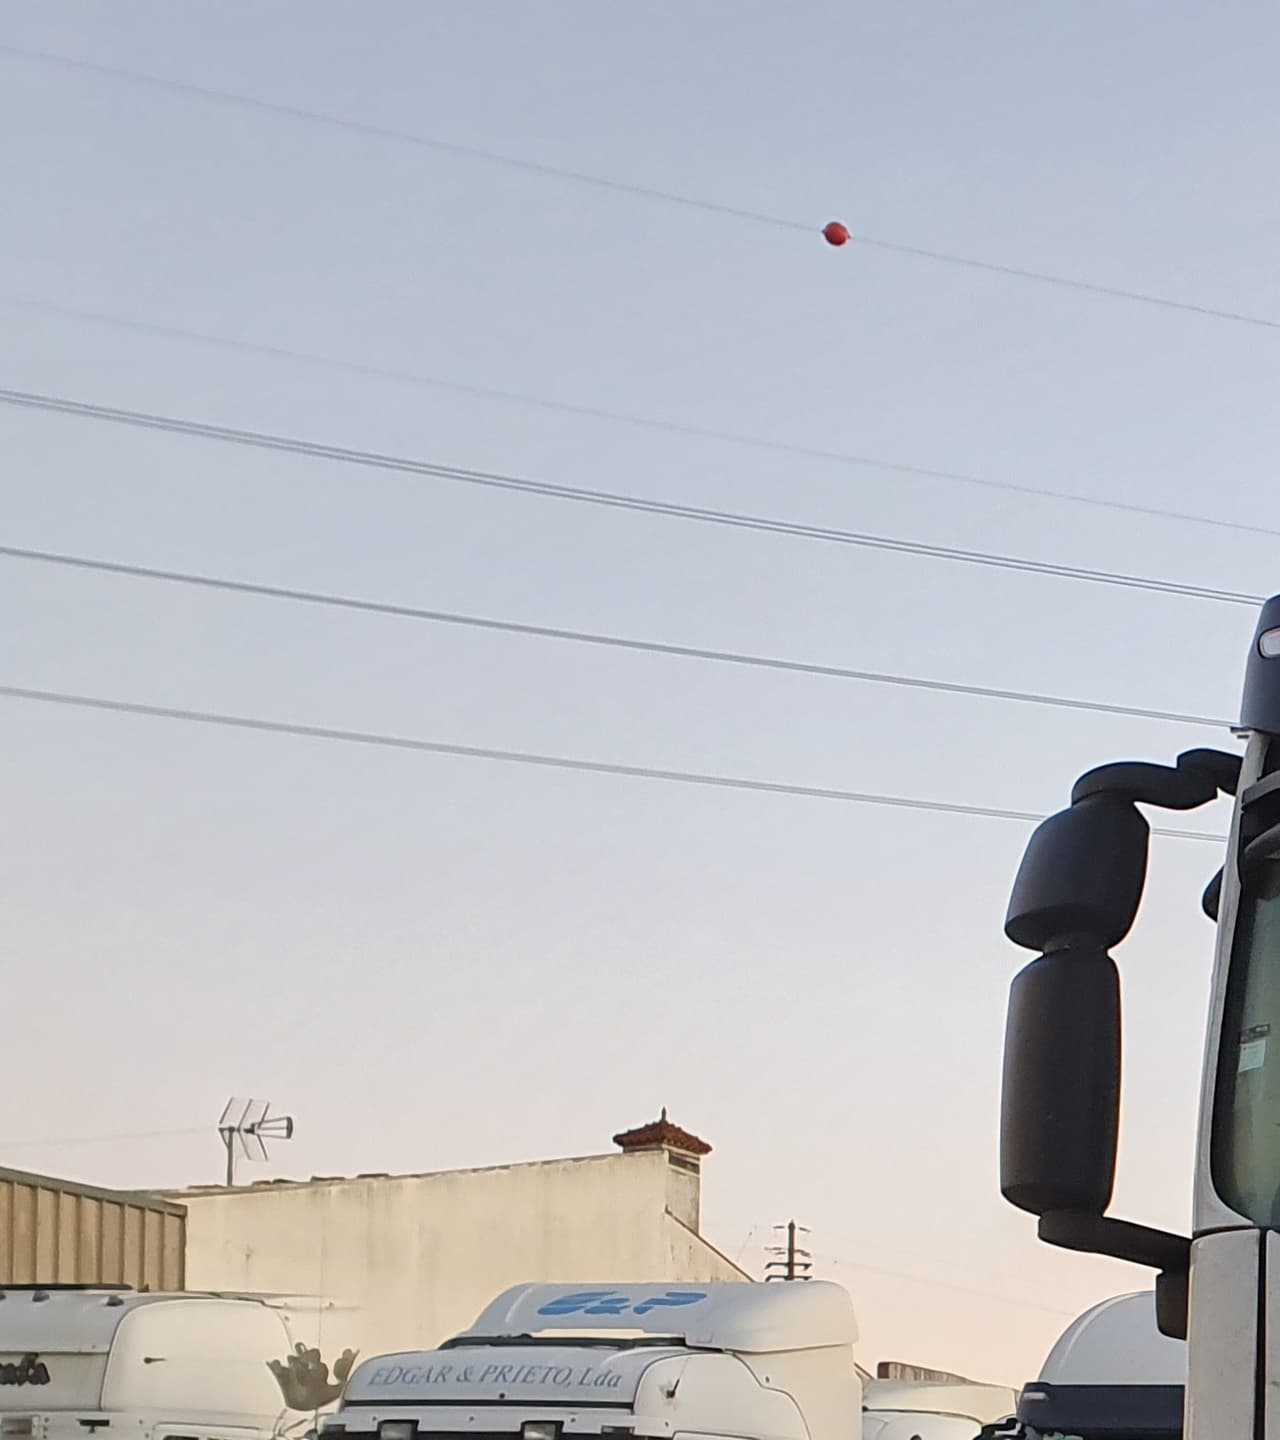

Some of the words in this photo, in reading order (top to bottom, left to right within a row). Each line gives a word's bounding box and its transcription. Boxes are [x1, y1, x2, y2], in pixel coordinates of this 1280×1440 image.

[368, 1365, 454, 1386] EDGAR
[456, 1364, 475, 1383] &
[479, 1364, 573, 1389] PRIETO,
[578, 1366, 623, 1388] Lda
